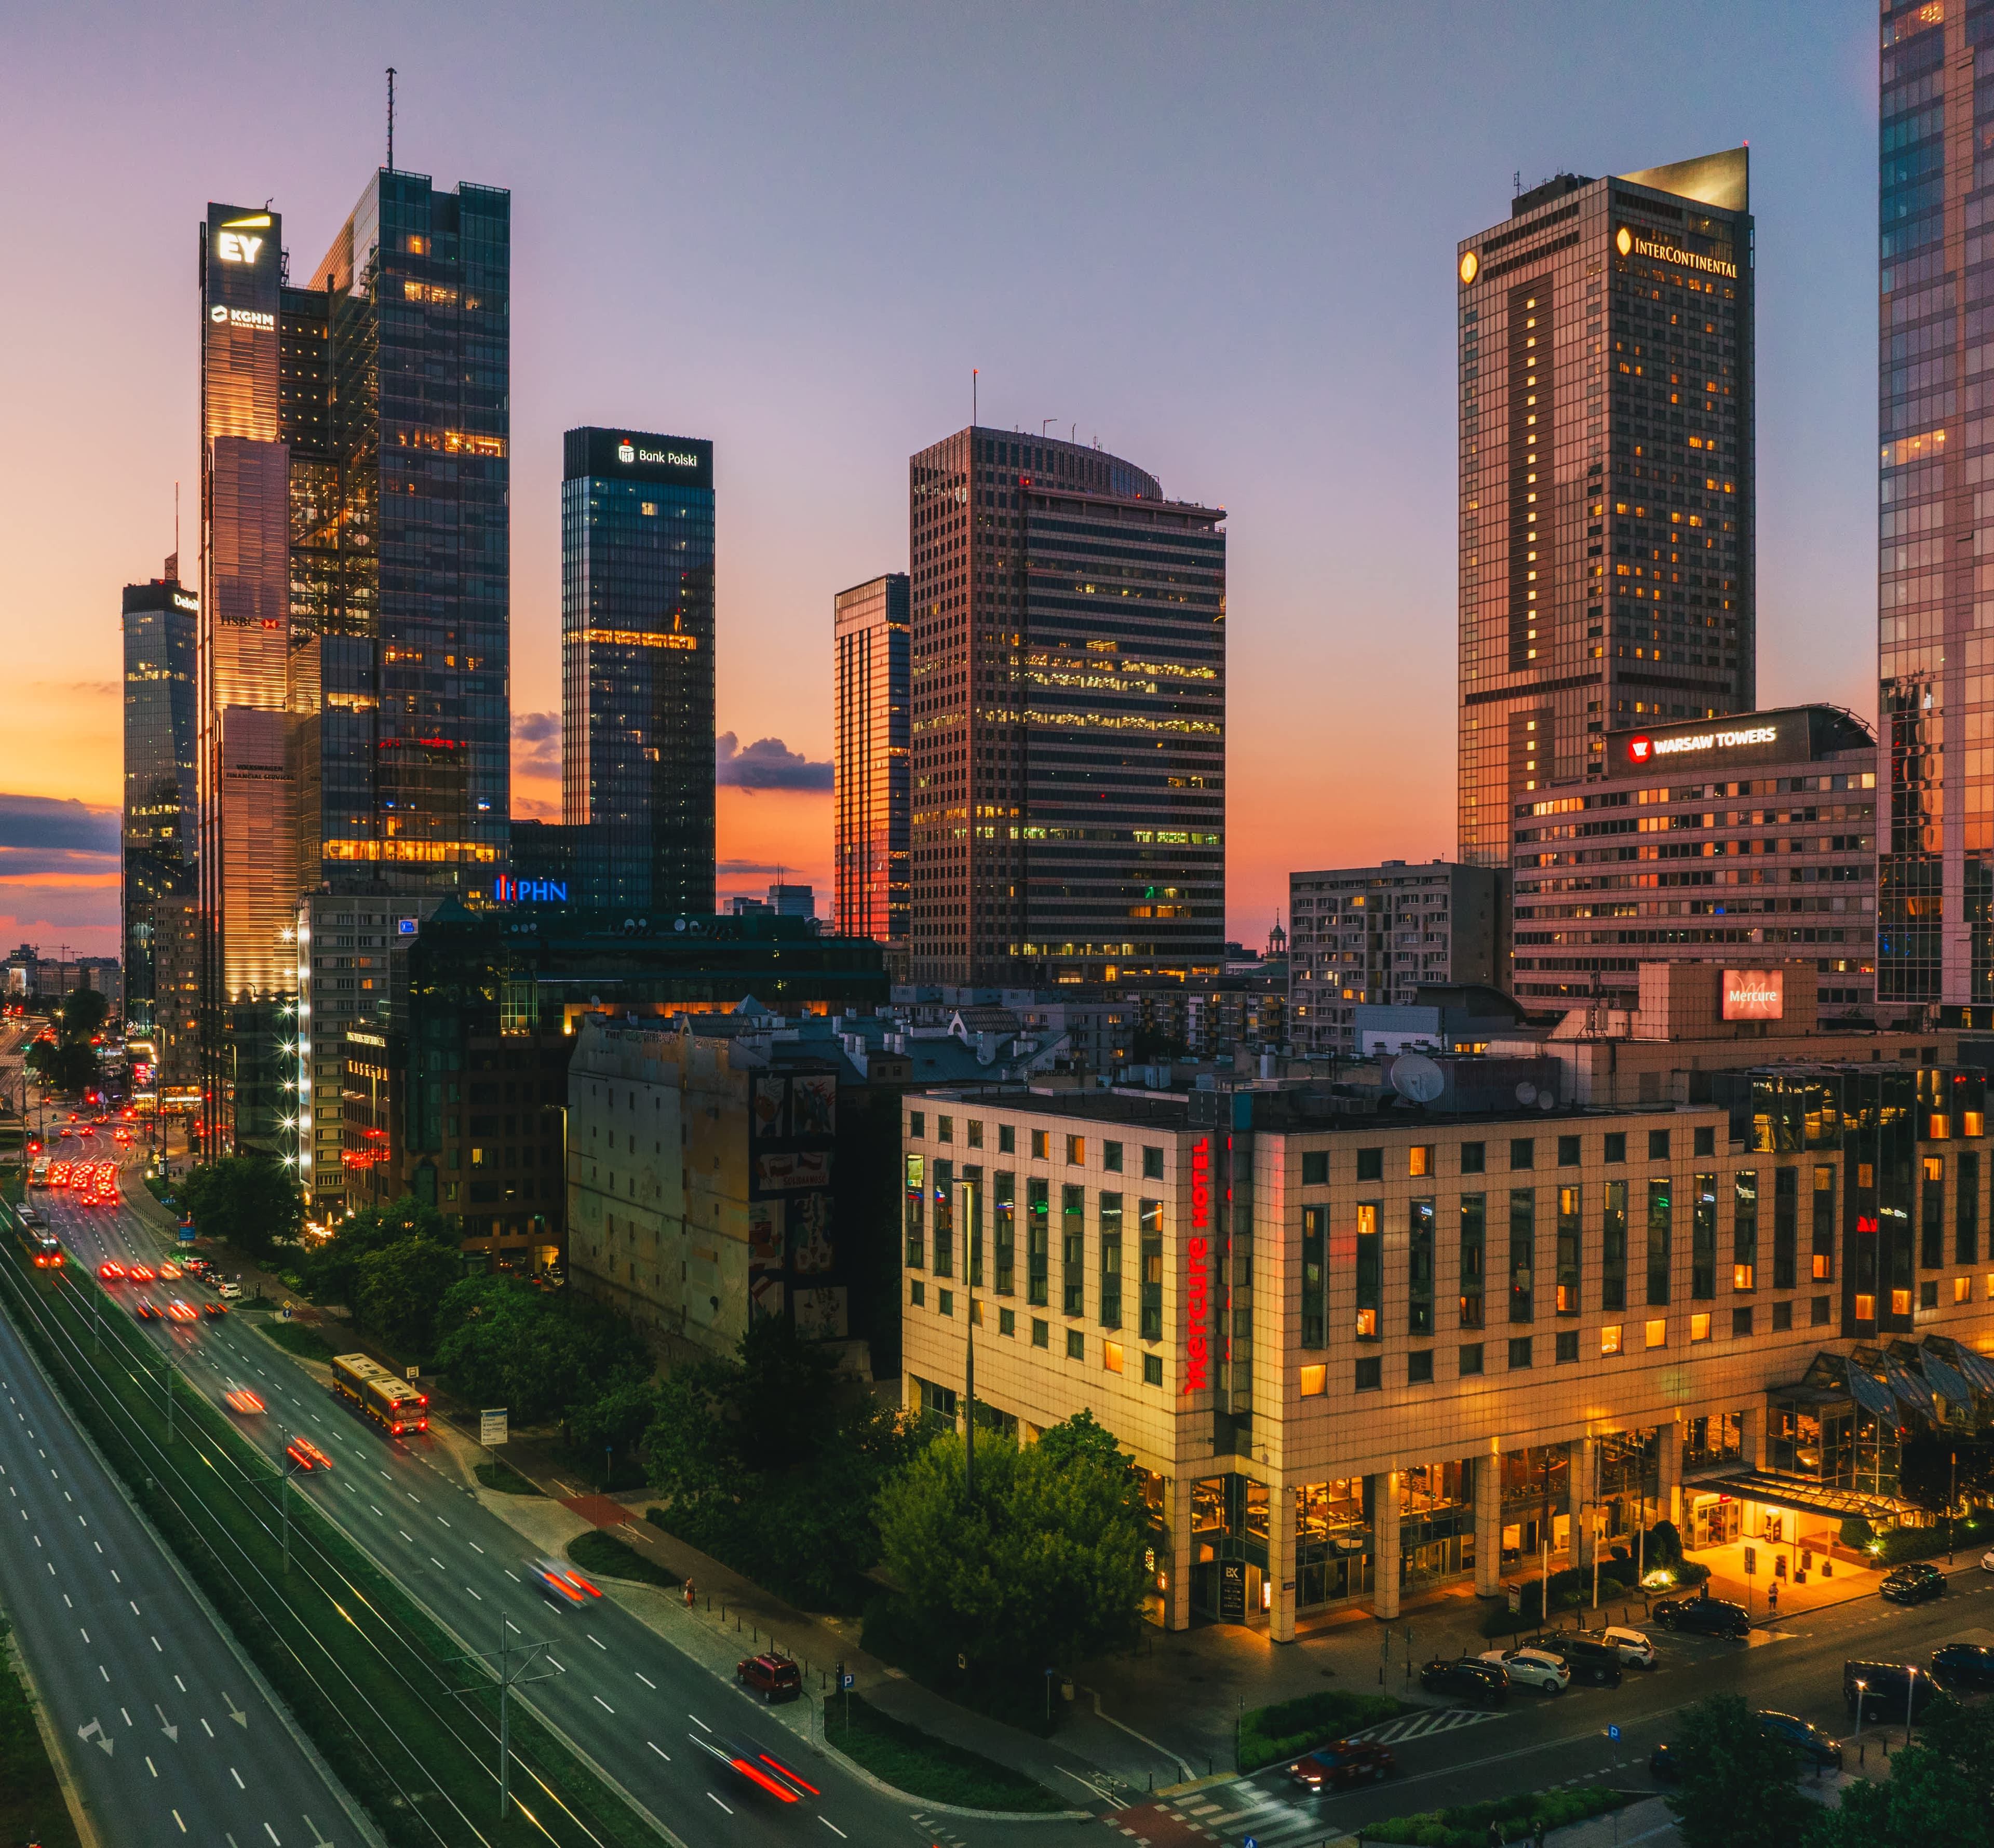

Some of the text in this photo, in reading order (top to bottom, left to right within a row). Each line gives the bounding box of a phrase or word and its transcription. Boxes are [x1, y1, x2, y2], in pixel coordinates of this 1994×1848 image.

[219, 232, 262, 263] EY
[231, 309, 274, 326] KGHM
[639, 450, 665, 463] Bank
[668, 452, 697, 467] Polski
[1653, 727, 1776, 754] WARSAW TOWERS
[519, 882, 567, 901] PHN
[1730, 990, 1777, 1002] Mercure
[348, 1060, 388, 1081] KASKADA
[1192, 1137, 1208, 1227] HOTEL
[845, 1675, 852, 1687] P
[1611, 1726, 1618, 1738] P
